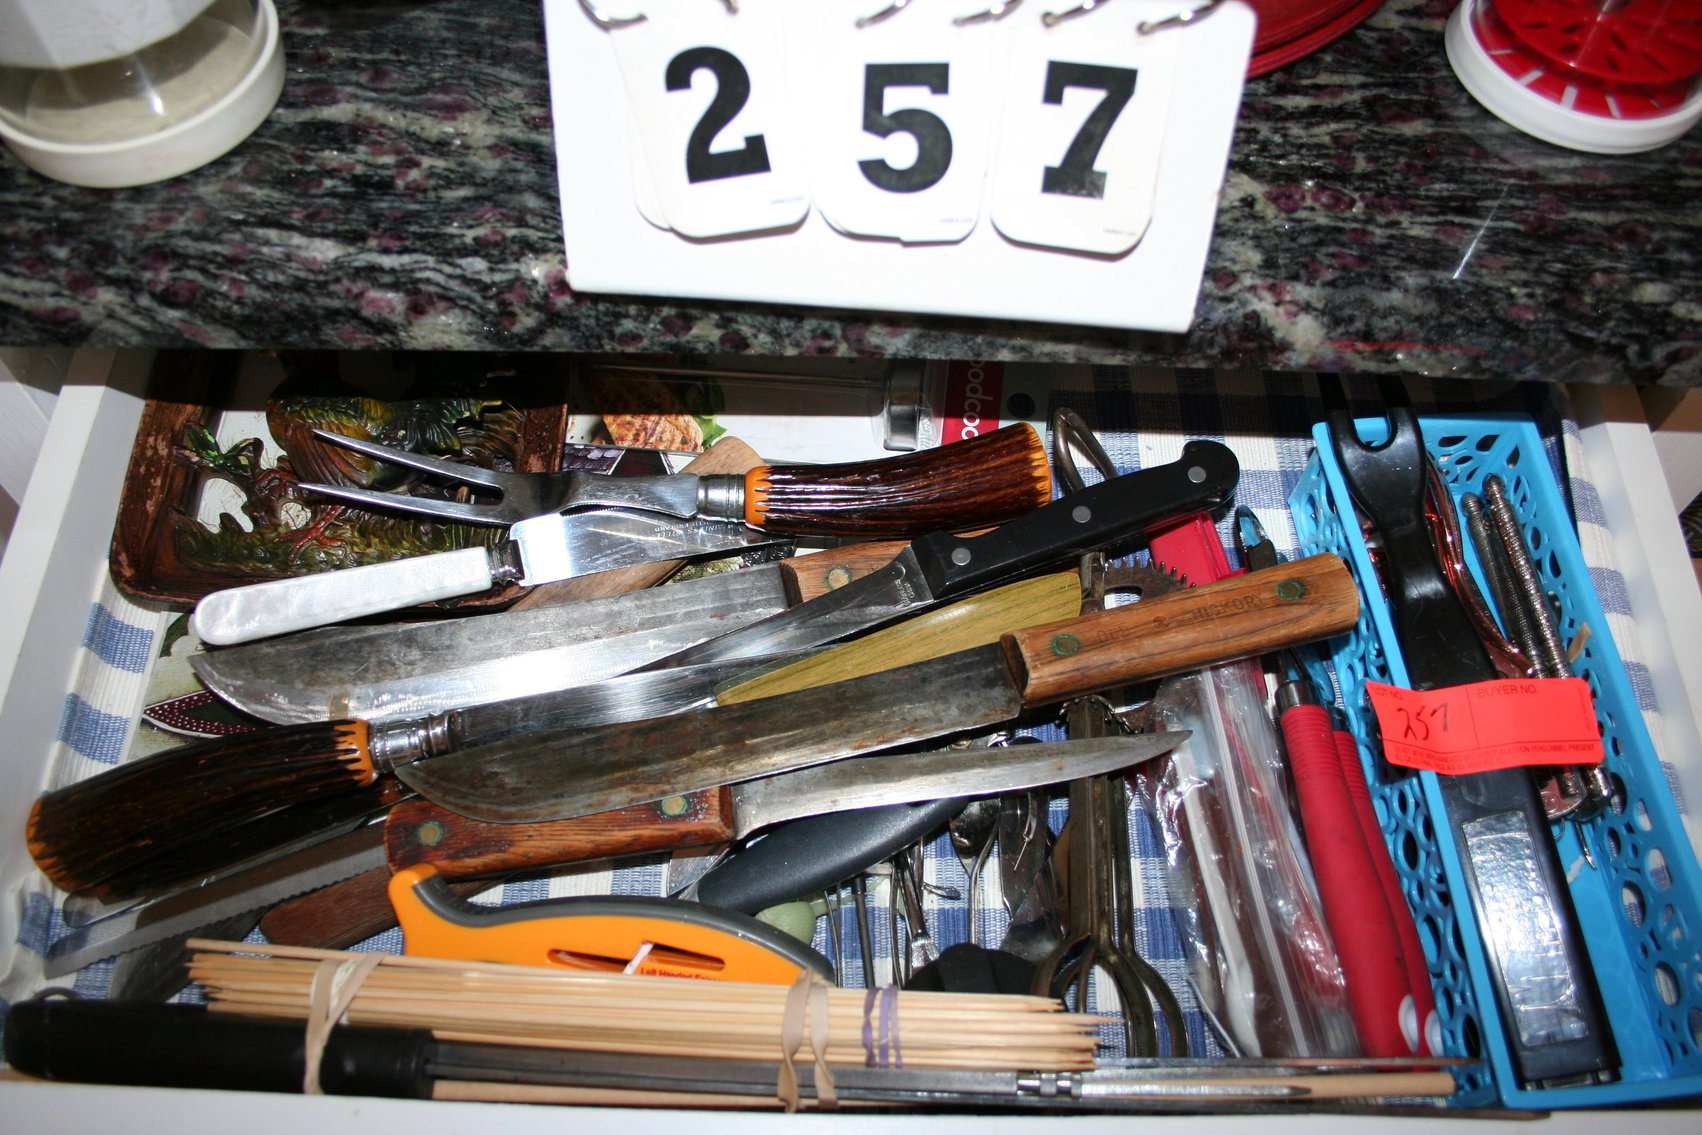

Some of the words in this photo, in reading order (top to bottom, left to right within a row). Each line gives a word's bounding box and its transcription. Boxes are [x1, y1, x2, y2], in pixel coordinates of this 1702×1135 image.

[665, 46, 771, 184] 2
[857, 61, 953, 193] 5
[1040, 60, 1138, 199] 7
[1477, 684, 1518, 698] BUYER
[1397, 702, 1449, 741] 257
[1568, 743, 1595, 752] PRESENT
